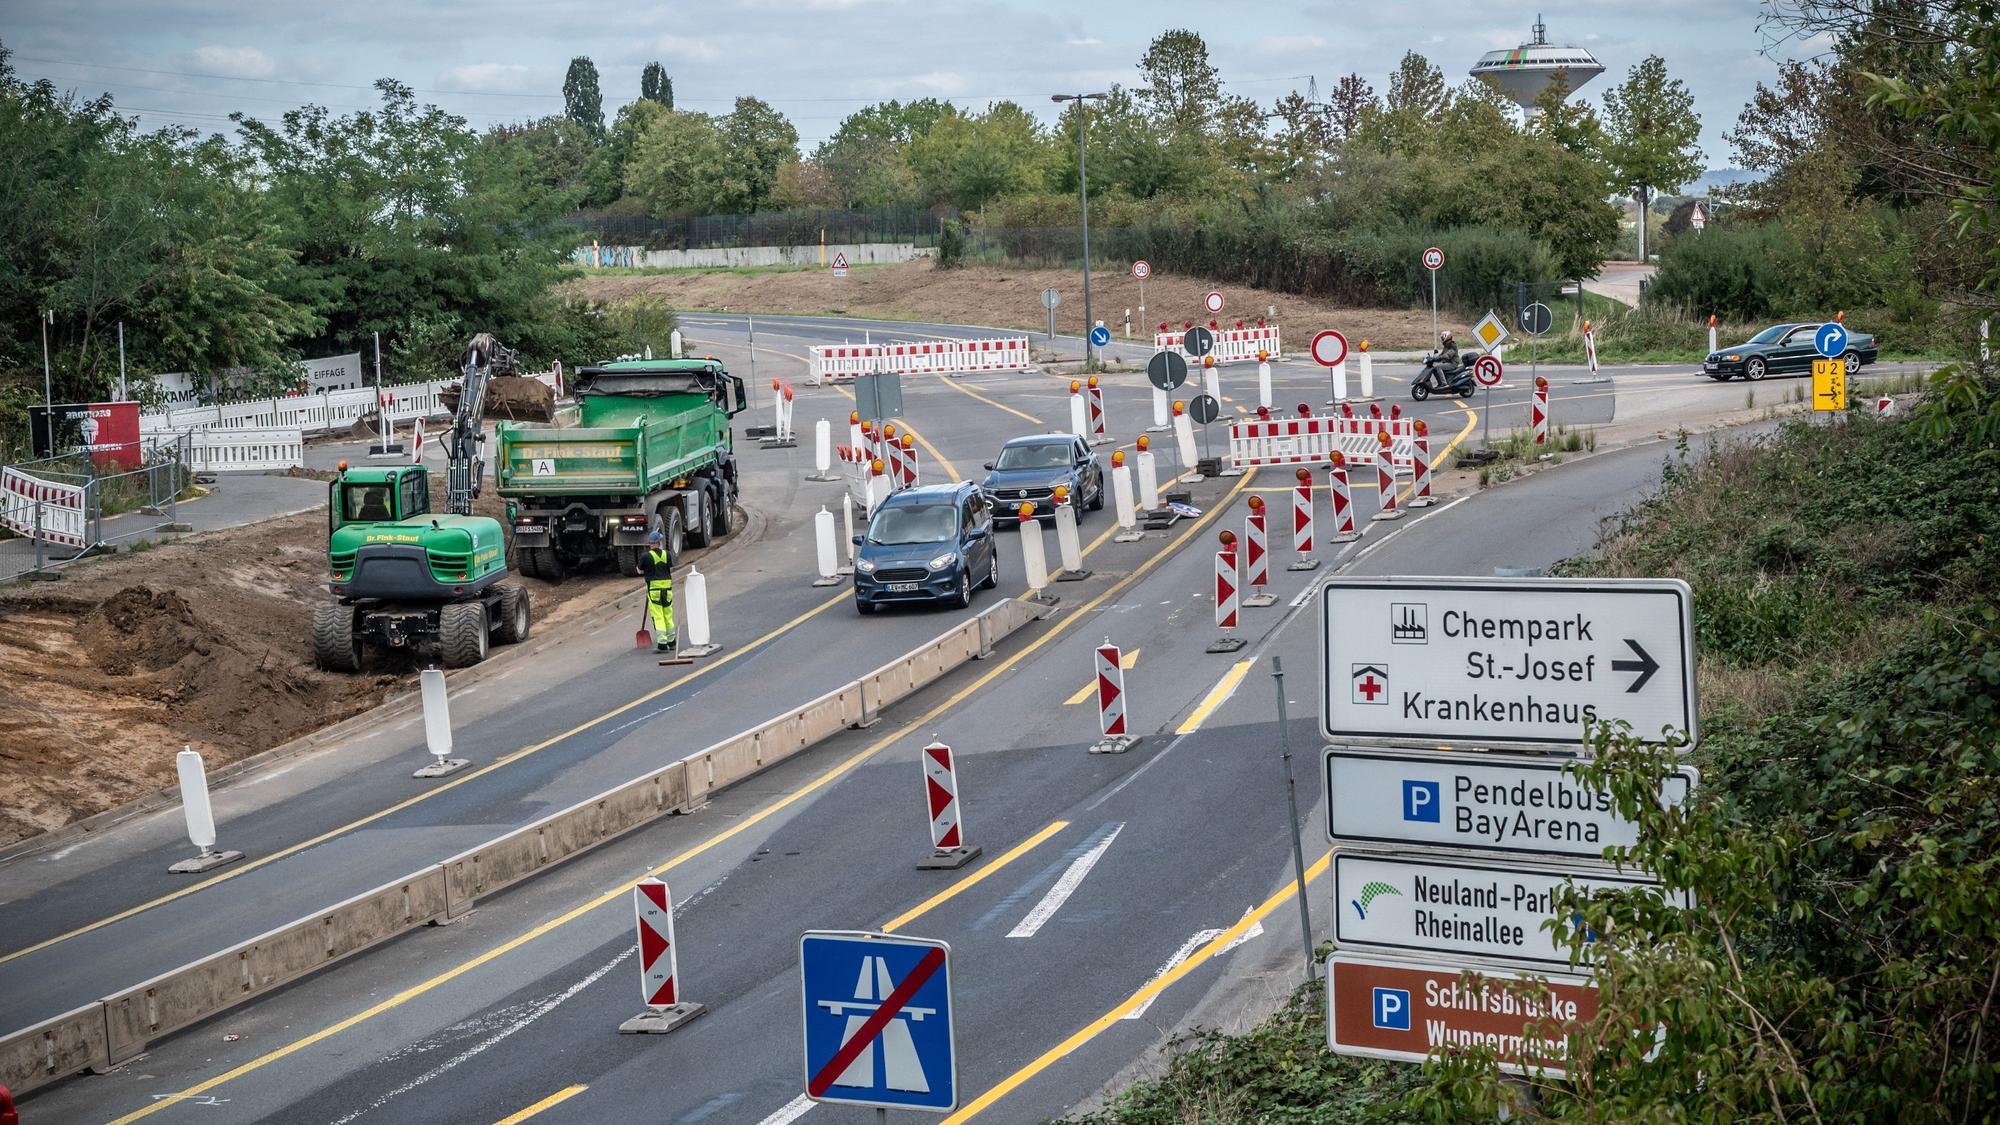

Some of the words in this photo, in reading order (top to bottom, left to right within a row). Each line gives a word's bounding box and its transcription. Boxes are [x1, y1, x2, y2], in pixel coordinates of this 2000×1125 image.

[314, 367, 346, 380] EIFFAGE
[1817, 363, 1826, 374] U
[1830, 362, 1837, 375] 2
[538, 461, 550, 474] A
[377, 534, 419, 542] Fink-Stauf
[1442, 610, 1594, 647] Chempark
[1466, 651, 1596, 682] St.-Josef
[1403, 691, 1598, 725] Krankenhaus
[1411, 785, 1432, 817] P
[1454, 775, 1611, 812] Pendelbus
[1415, 909, 1524, 946] Rheinallee
[1381, 993, 1402, 1024] P
